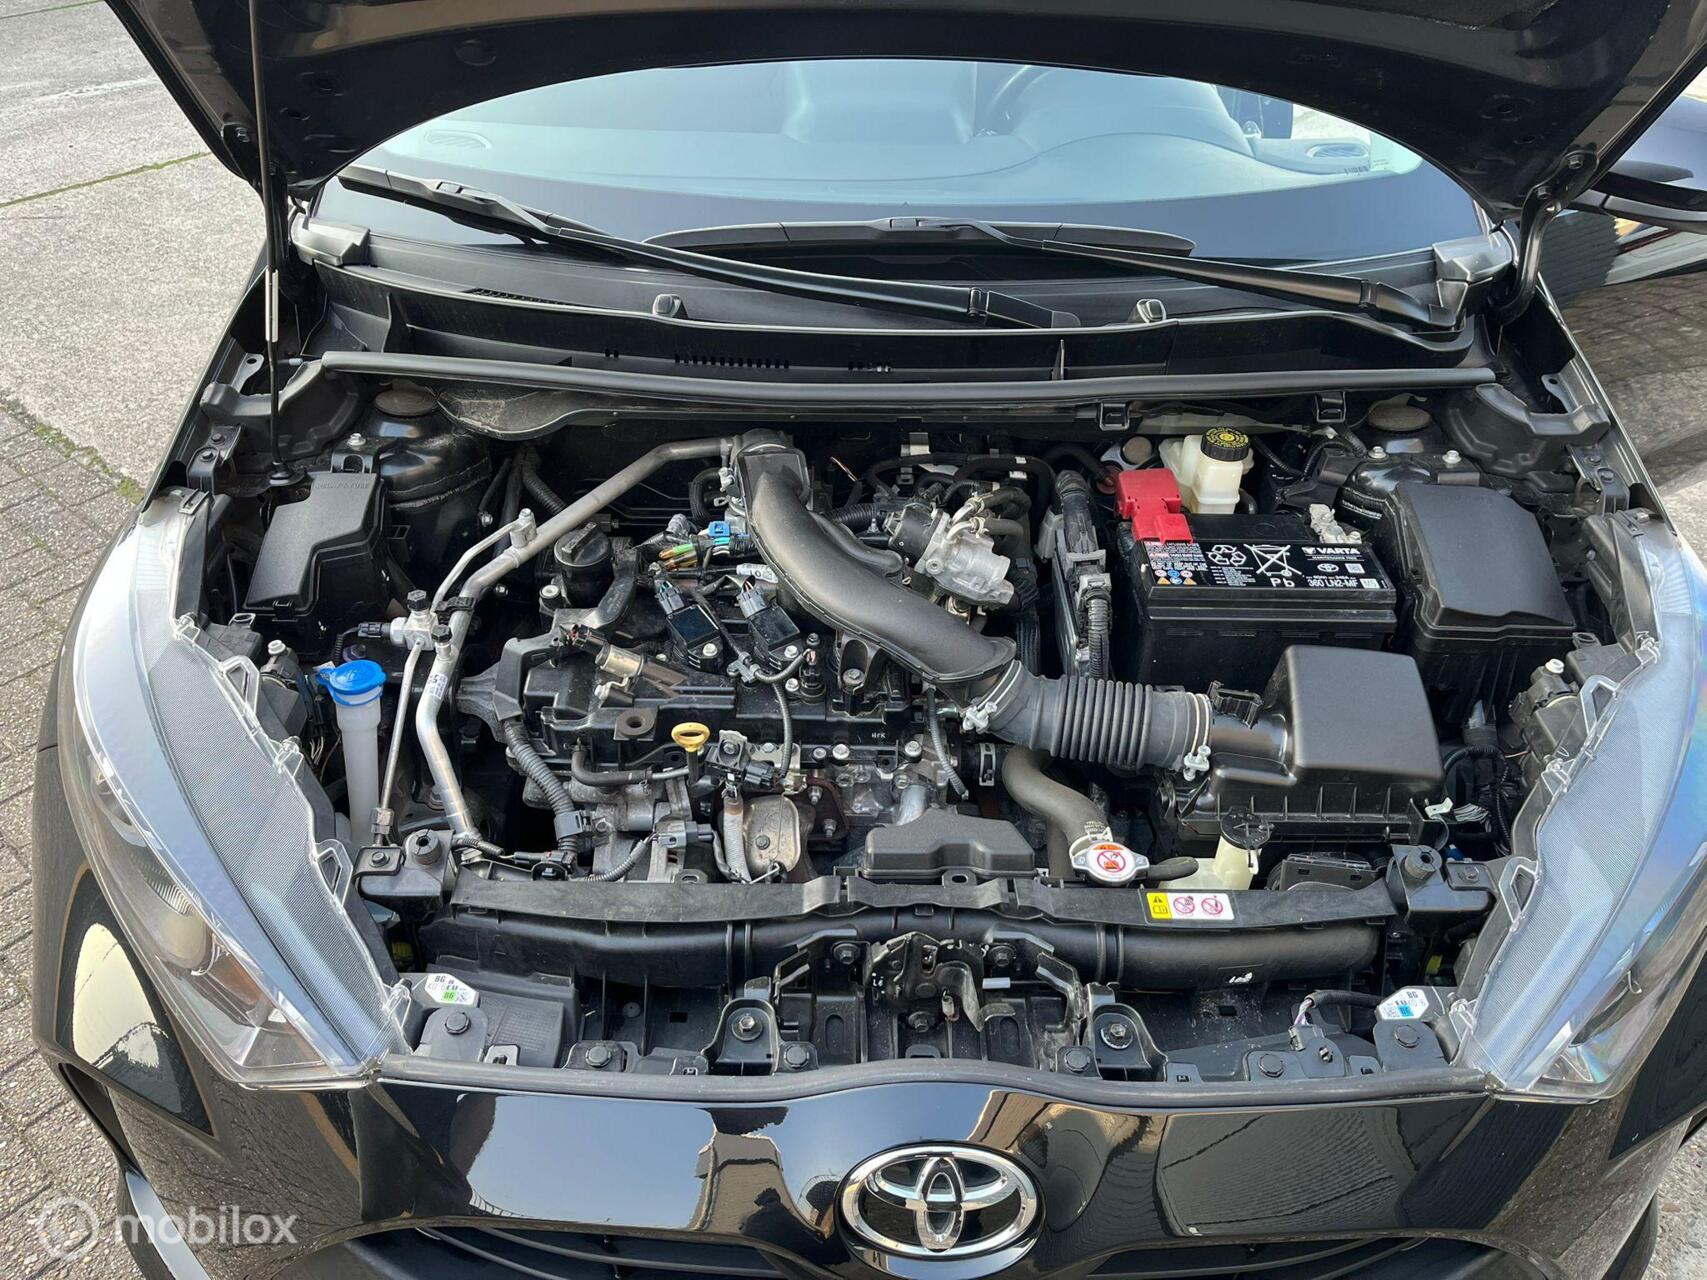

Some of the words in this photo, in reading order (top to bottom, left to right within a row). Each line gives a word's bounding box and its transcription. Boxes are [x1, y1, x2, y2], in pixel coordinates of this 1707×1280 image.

[1316, 547, 1361, 555] VARTA
[1270, 577, 1296, 588] Pb
[1325, 579, 1359, 588] LN2-MF
